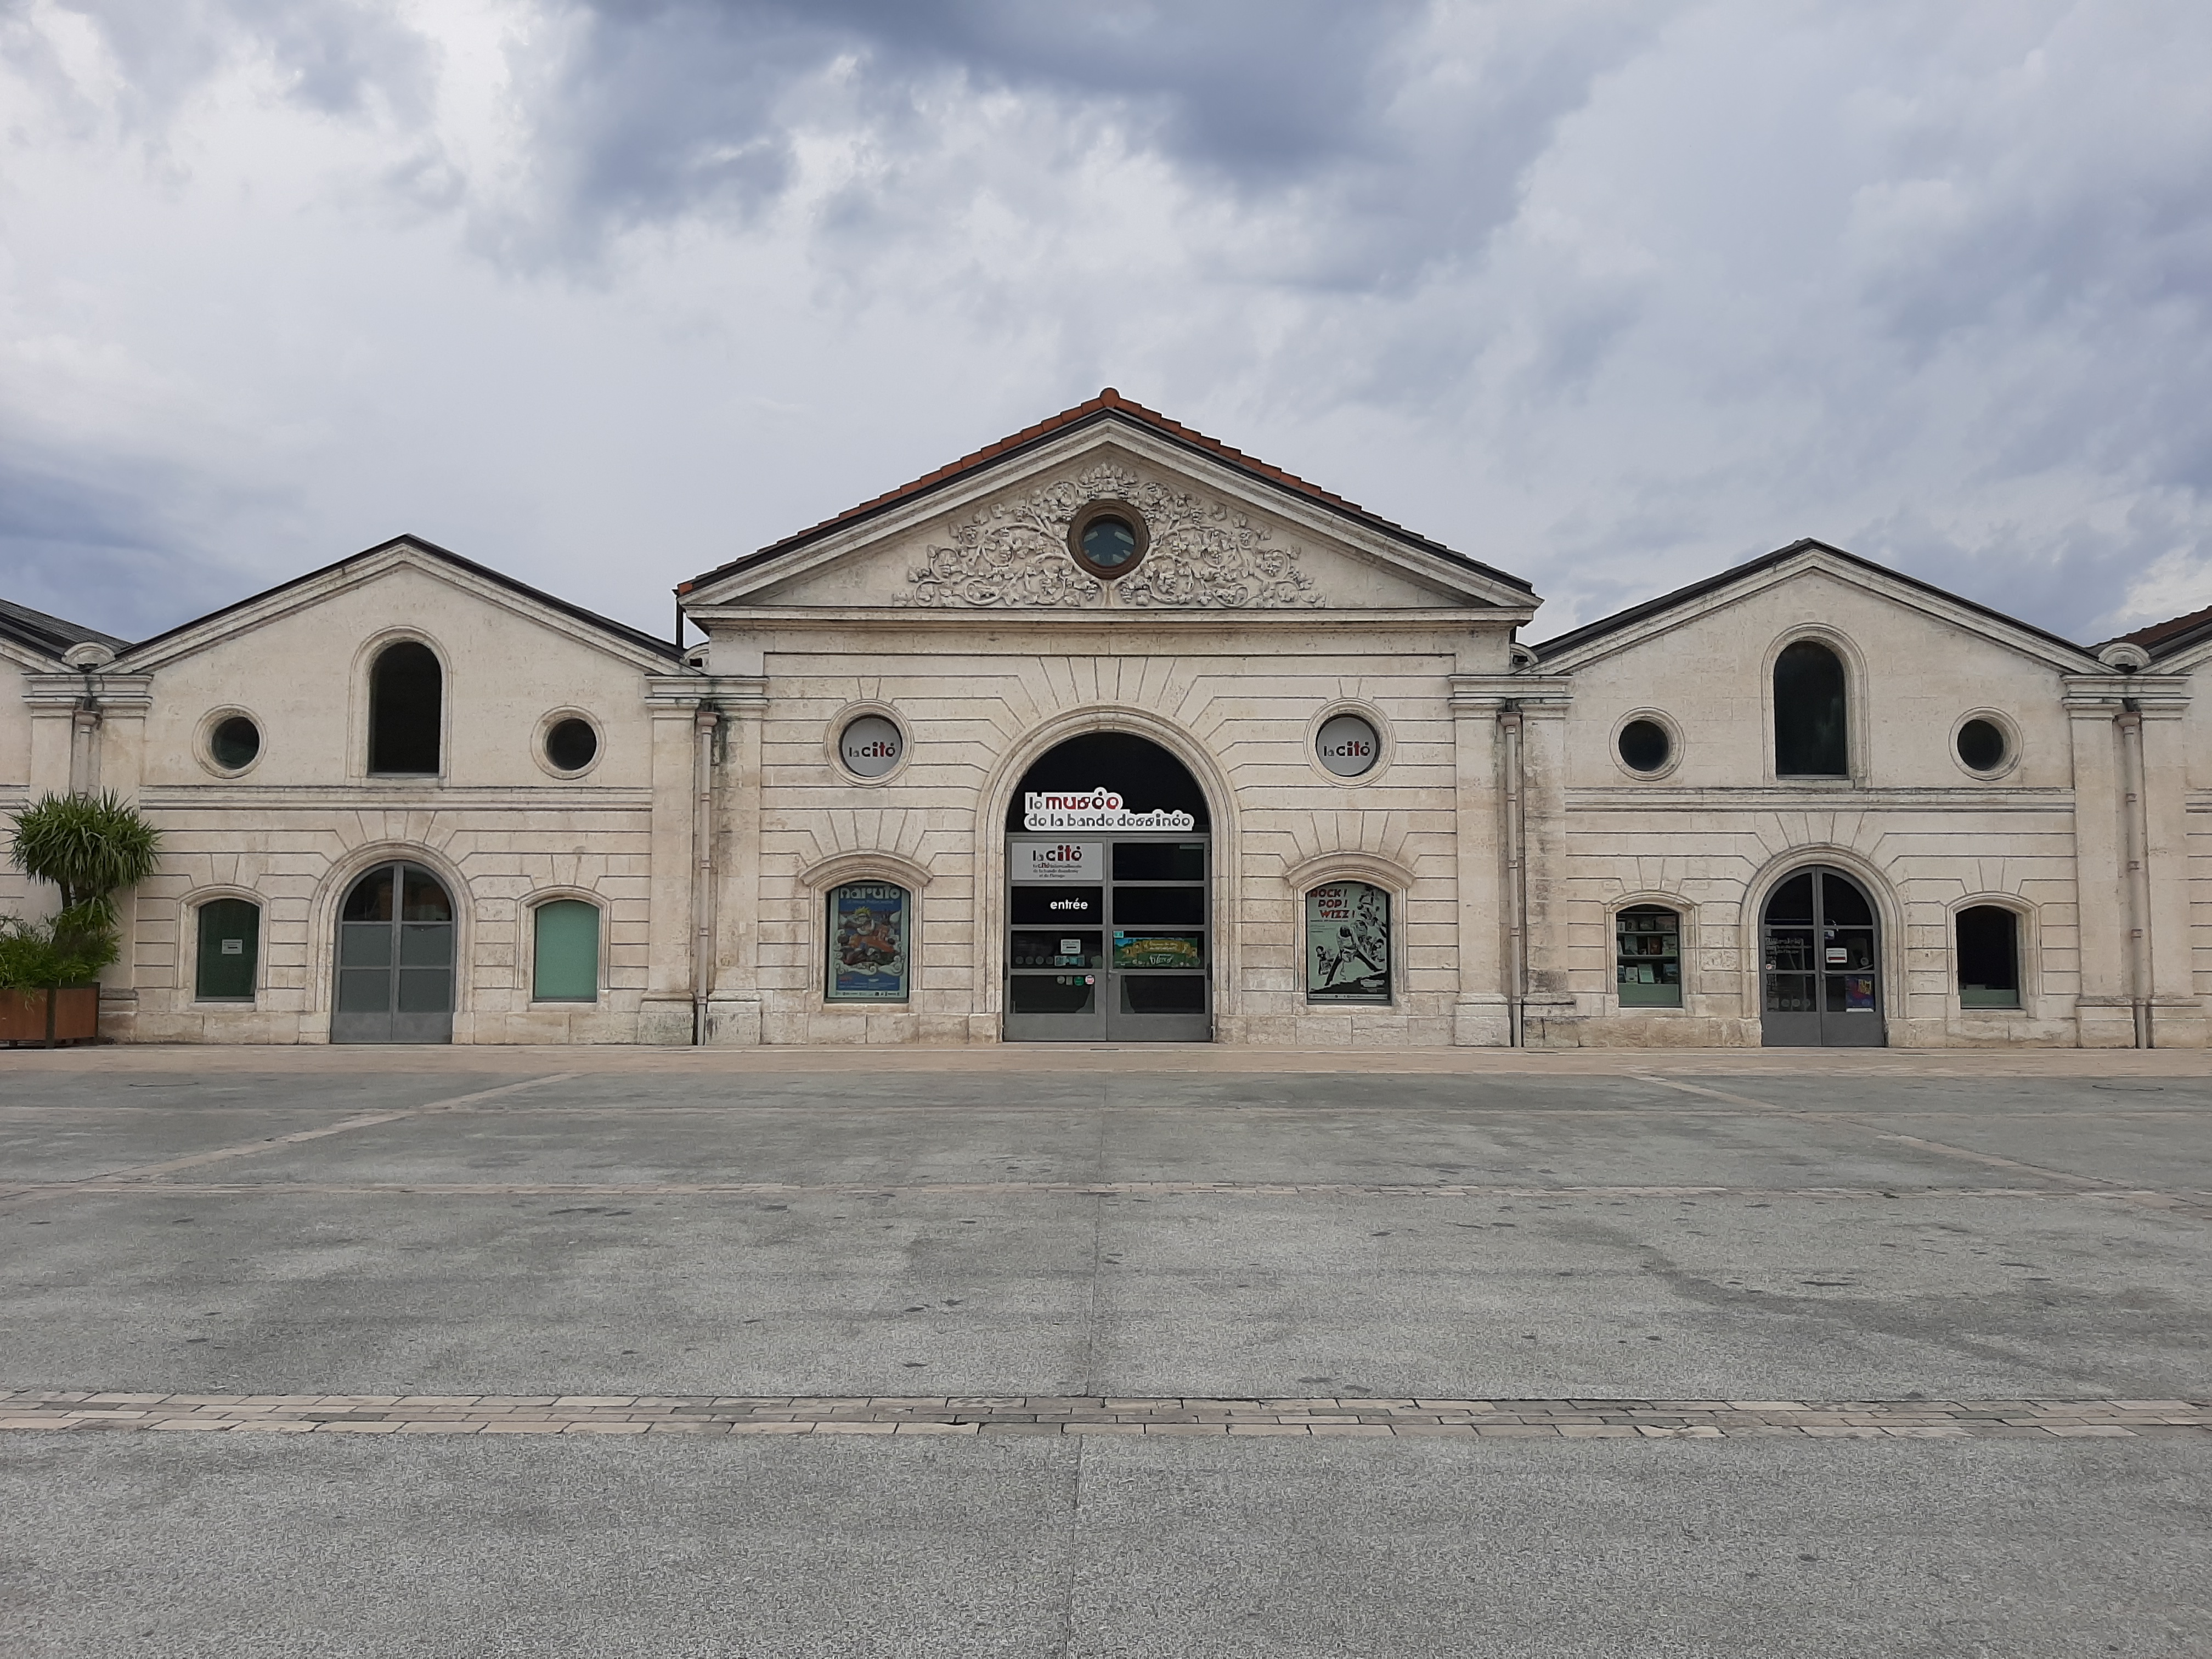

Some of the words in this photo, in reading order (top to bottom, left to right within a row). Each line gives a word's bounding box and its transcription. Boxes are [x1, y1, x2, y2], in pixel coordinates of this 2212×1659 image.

[849, 747, 860, 757] la
[1324, 746, 1335, 757] la
[1050, 813, 1064, 827] la
[1067, 813, 1114, 827] bande
[1032, 850, 1044, 861] la
[840, 885, 901, 899] naruto
[1310, 888, 1342, 898] ROCK
[1049, 897, 1088, 910] entrée
[1318, 899, 1342, 908] POP
[1319, 909, 1350, 919] WIZZ
